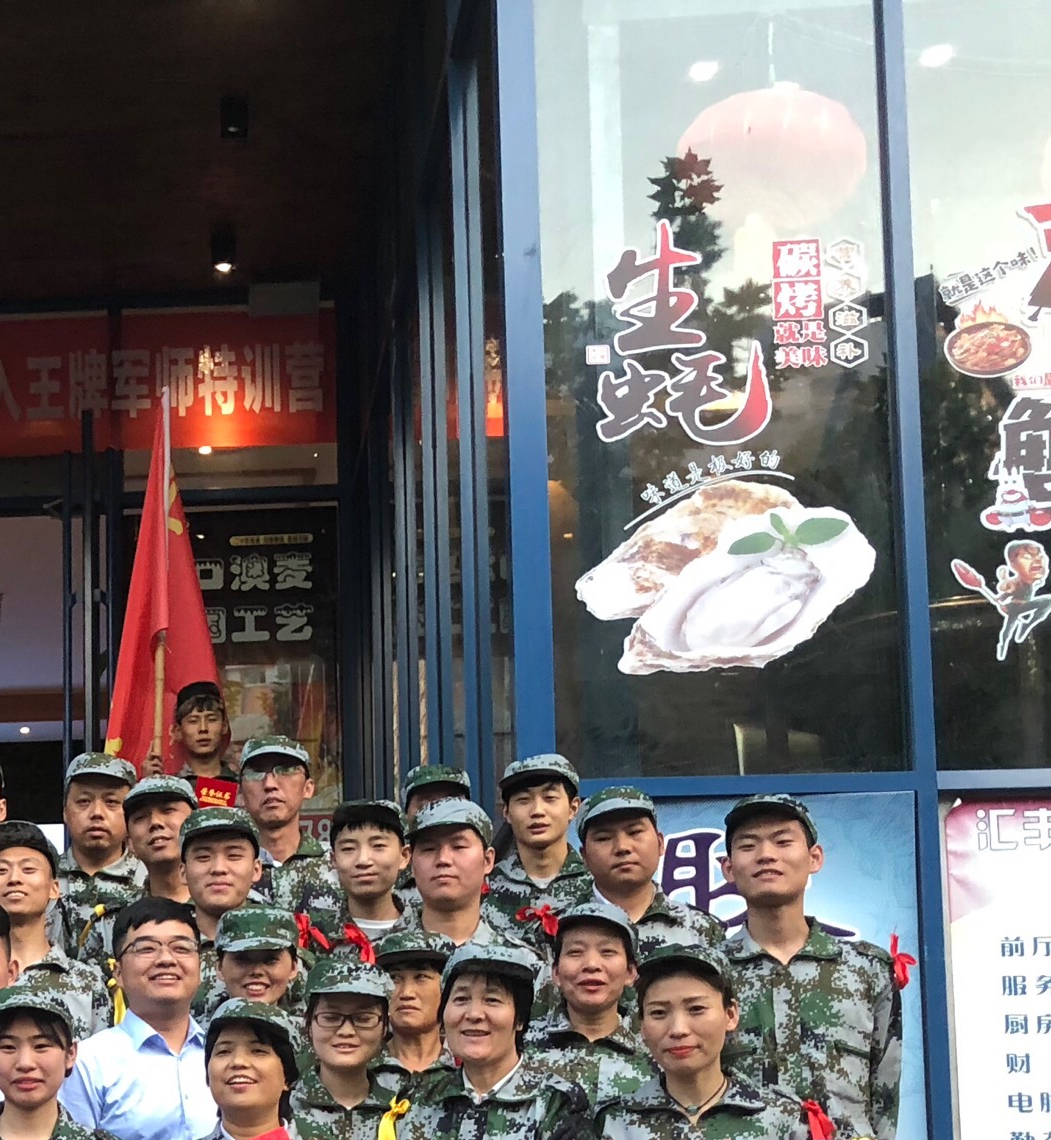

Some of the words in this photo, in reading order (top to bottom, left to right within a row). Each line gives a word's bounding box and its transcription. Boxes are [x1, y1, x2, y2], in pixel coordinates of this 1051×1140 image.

[596, 219, 773, 446] 生蚝
[774, 320, 828, 344] 就是
[775, 346, 829, 370] 美味
[640, 449, 781, 505] 味道是极好的
[1006, 1053, 1031, 1074] 财
